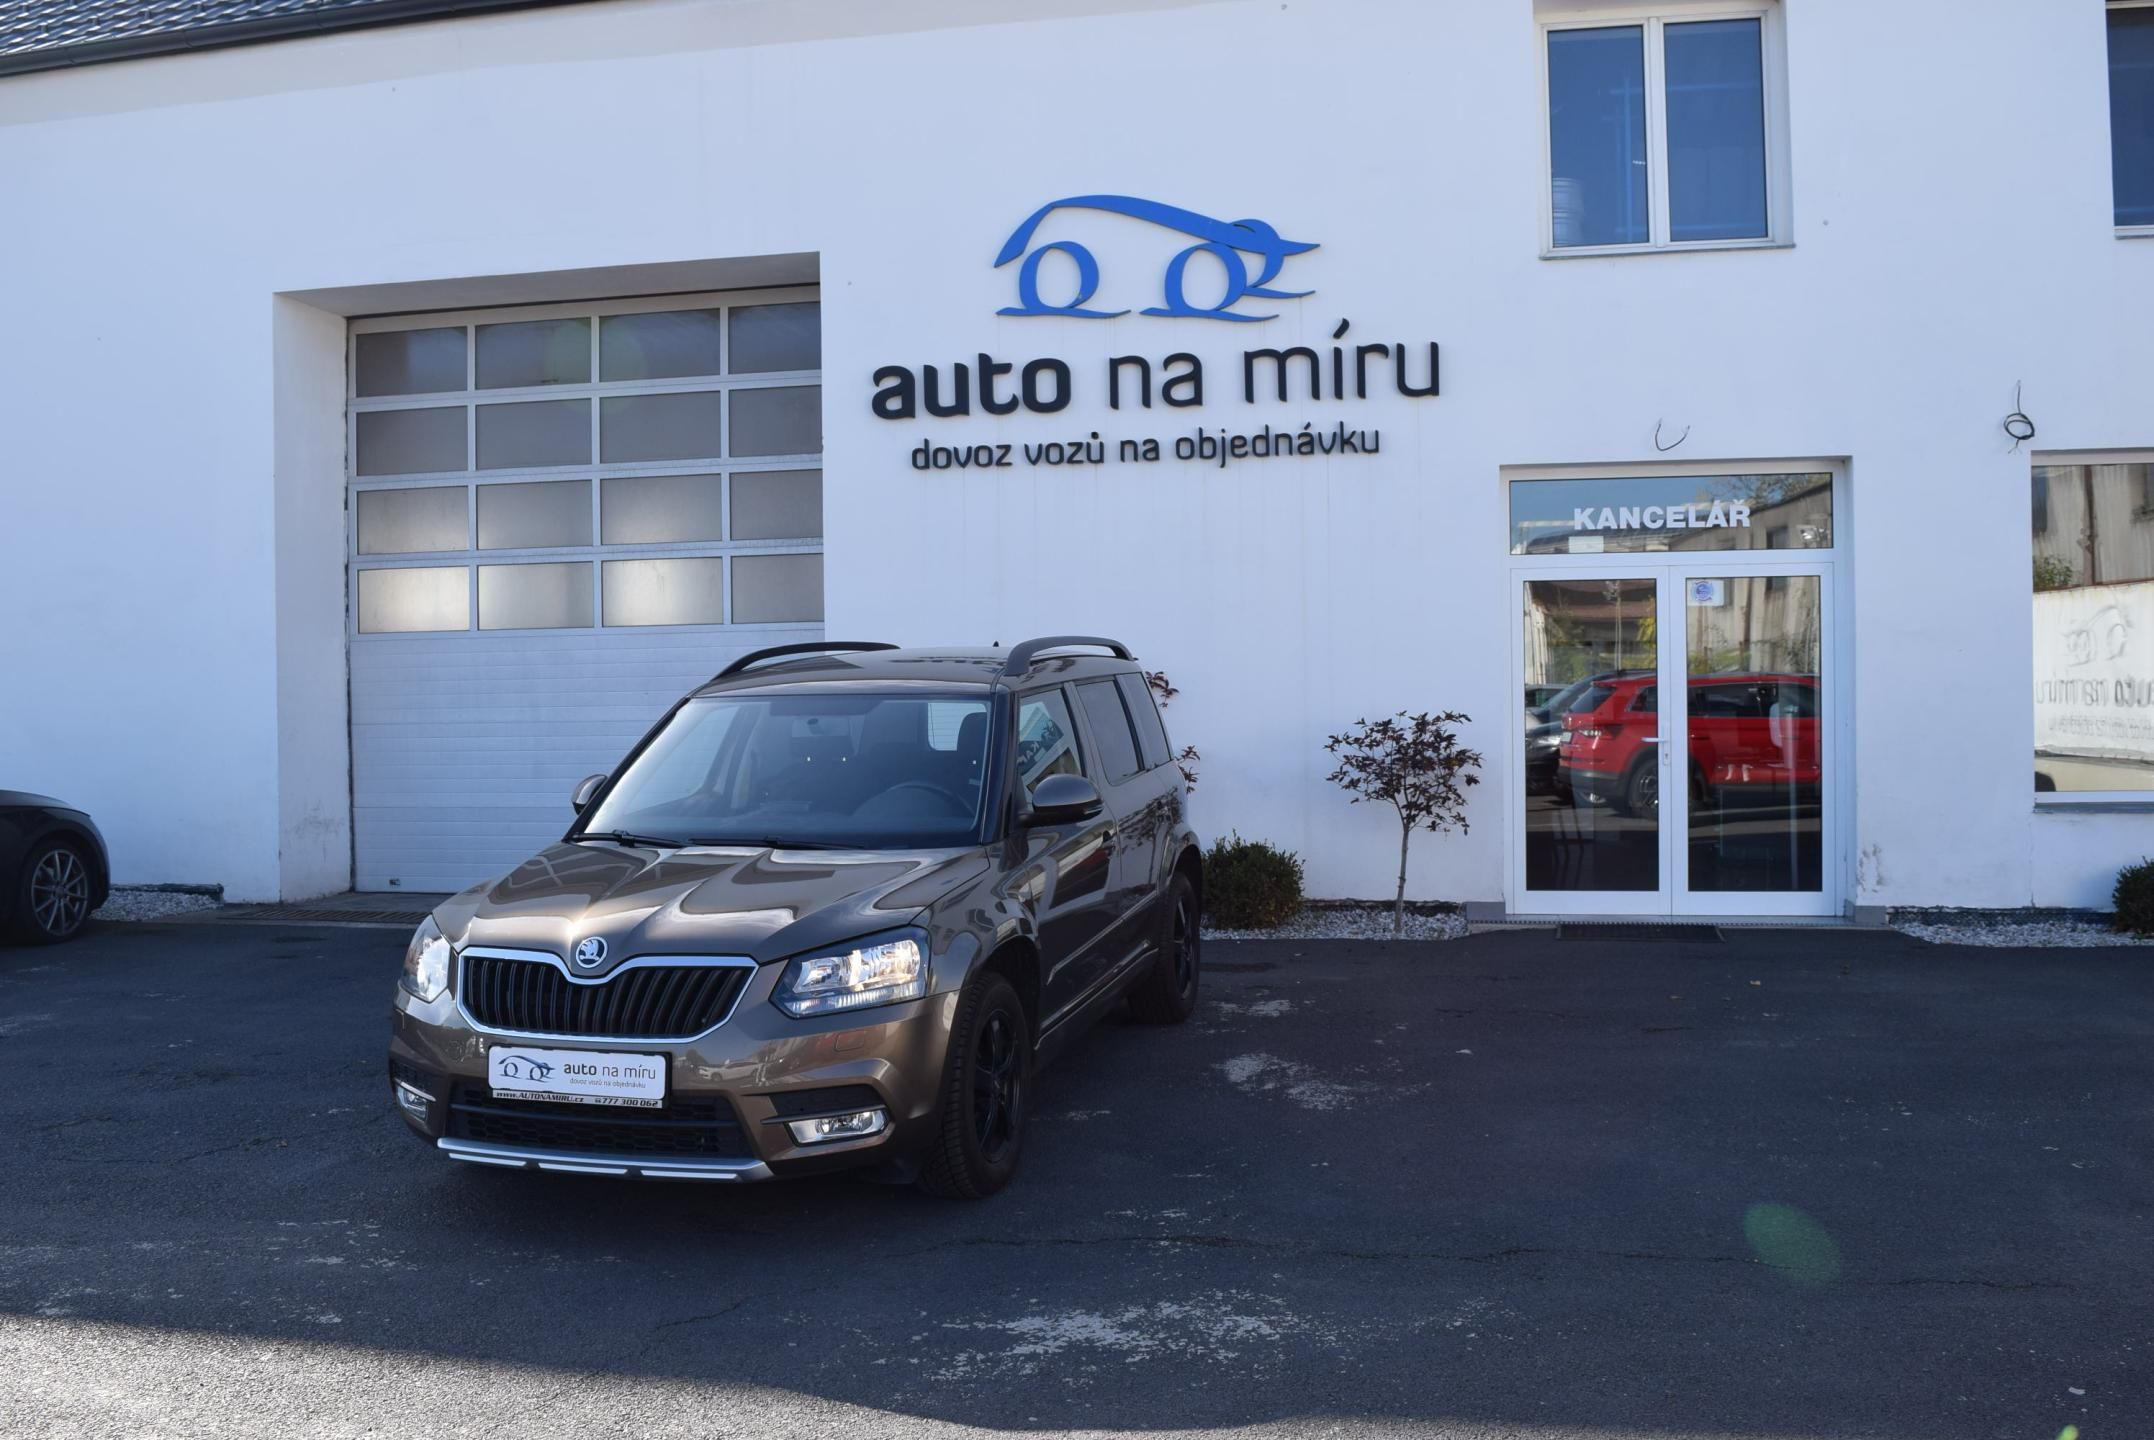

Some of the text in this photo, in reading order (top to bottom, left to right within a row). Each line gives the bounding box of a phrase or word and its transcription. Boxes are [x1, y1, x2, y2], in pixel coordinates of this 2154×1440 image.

[871, 317, 1440, 421] auto na míru
[911, 420, 1380, 471] dovoz vozů na objednávku
[1573, 499, 1751, 530] KANCELÁŘ
[563, 1063, 656, 1080] auto na míru
